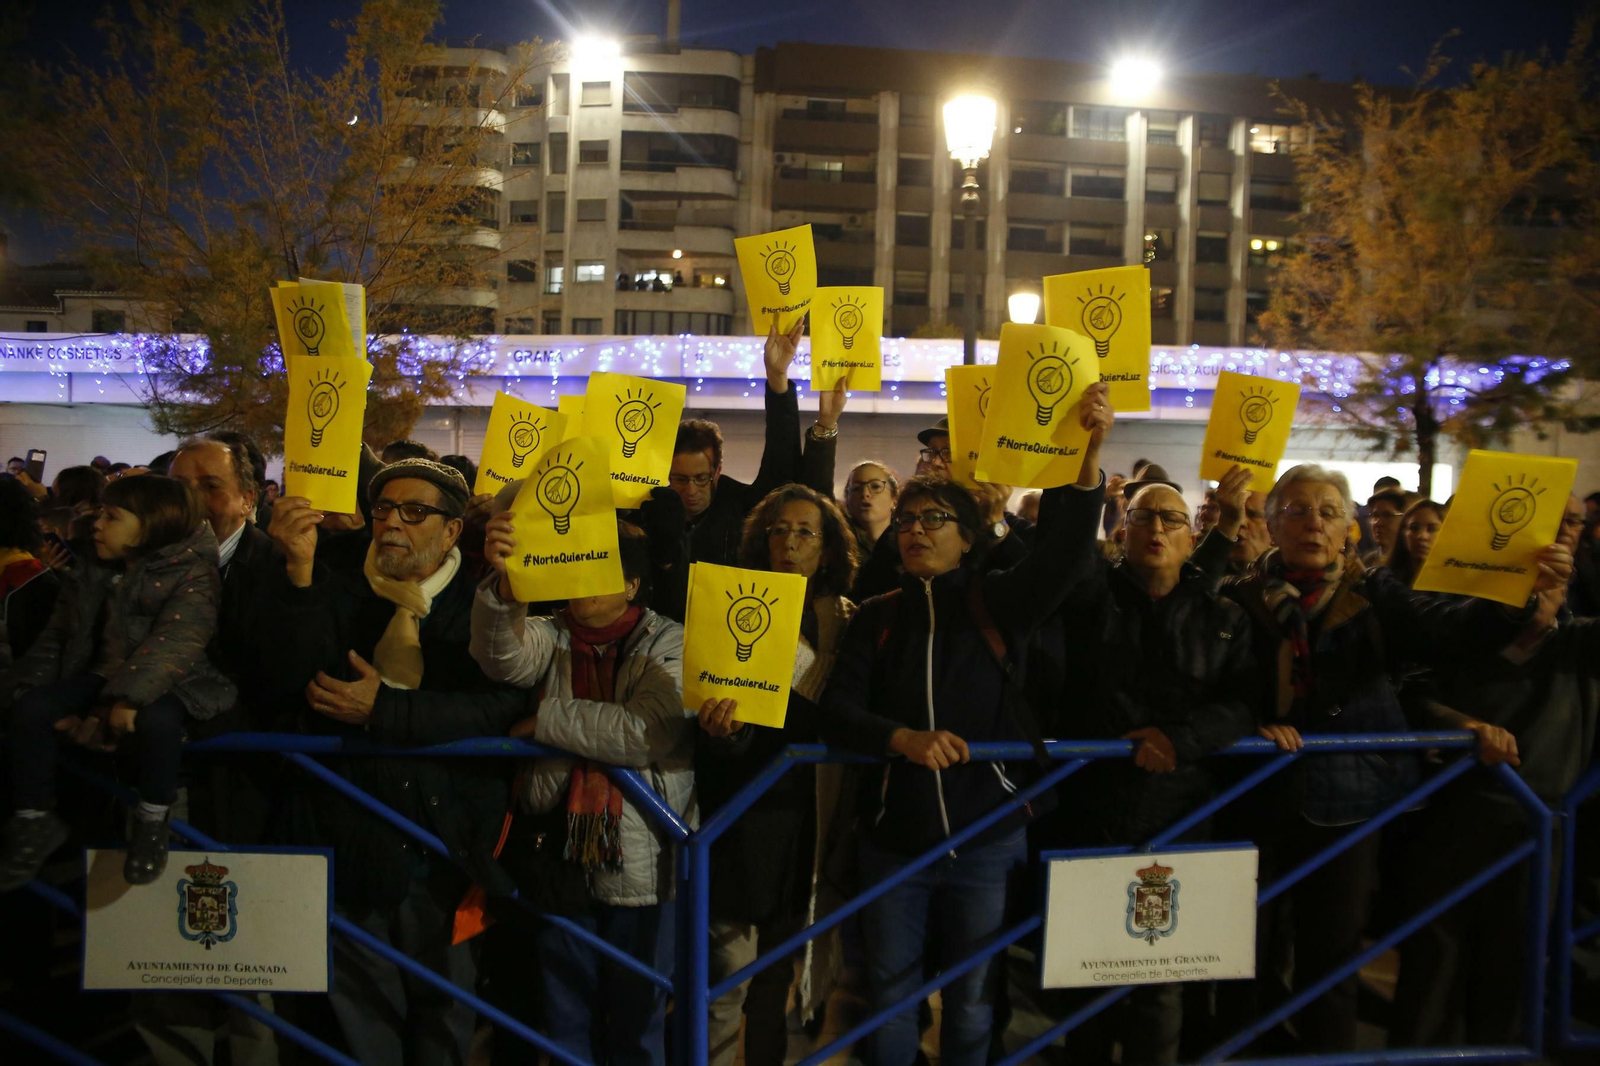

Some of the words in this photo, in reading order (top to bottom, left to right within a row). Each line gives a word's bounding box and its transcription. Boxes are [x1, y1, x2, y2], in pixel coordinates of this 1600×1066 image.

[761, 297, 812, 315] #NorteQuiereLu
[513, 349, 564, 363] GRAMA
[821, 360, 875, 368] #NorteQuiereLuz
[997, 435, 1080, 456] #NorteQuiereLuz
[1215, 450, 1274, 469] #NorteQuiereLuz
[289, 461, 348, 478] #NorteQuiereLuz
[610, 472, 660, 486] teQuiereLuz
[523, 550, 609, 567] #NorteQuiereLuz
[1444, 557, 1528, 575] #NorteQuiereLuz
[699, 671, 780, 692] #NorteQuiereLuz
[127, 960, 215, 972] AYUNTAMIENTO
[217, 963, 231, 972] DE
[234, 962, 287, 974] GRANADA
[1080, 957, 1157, 970] AYUNTAMIENTO
[1160, 957, 1172, 966] DE
[1174, 954, 1221, 966] GRANADA
[206, 974, 220, 985] de
[223, 975, 273, 987] Deportes
[1149, 968, 1163, 979] de
[1165, 967, 1208, 979] Deportes
